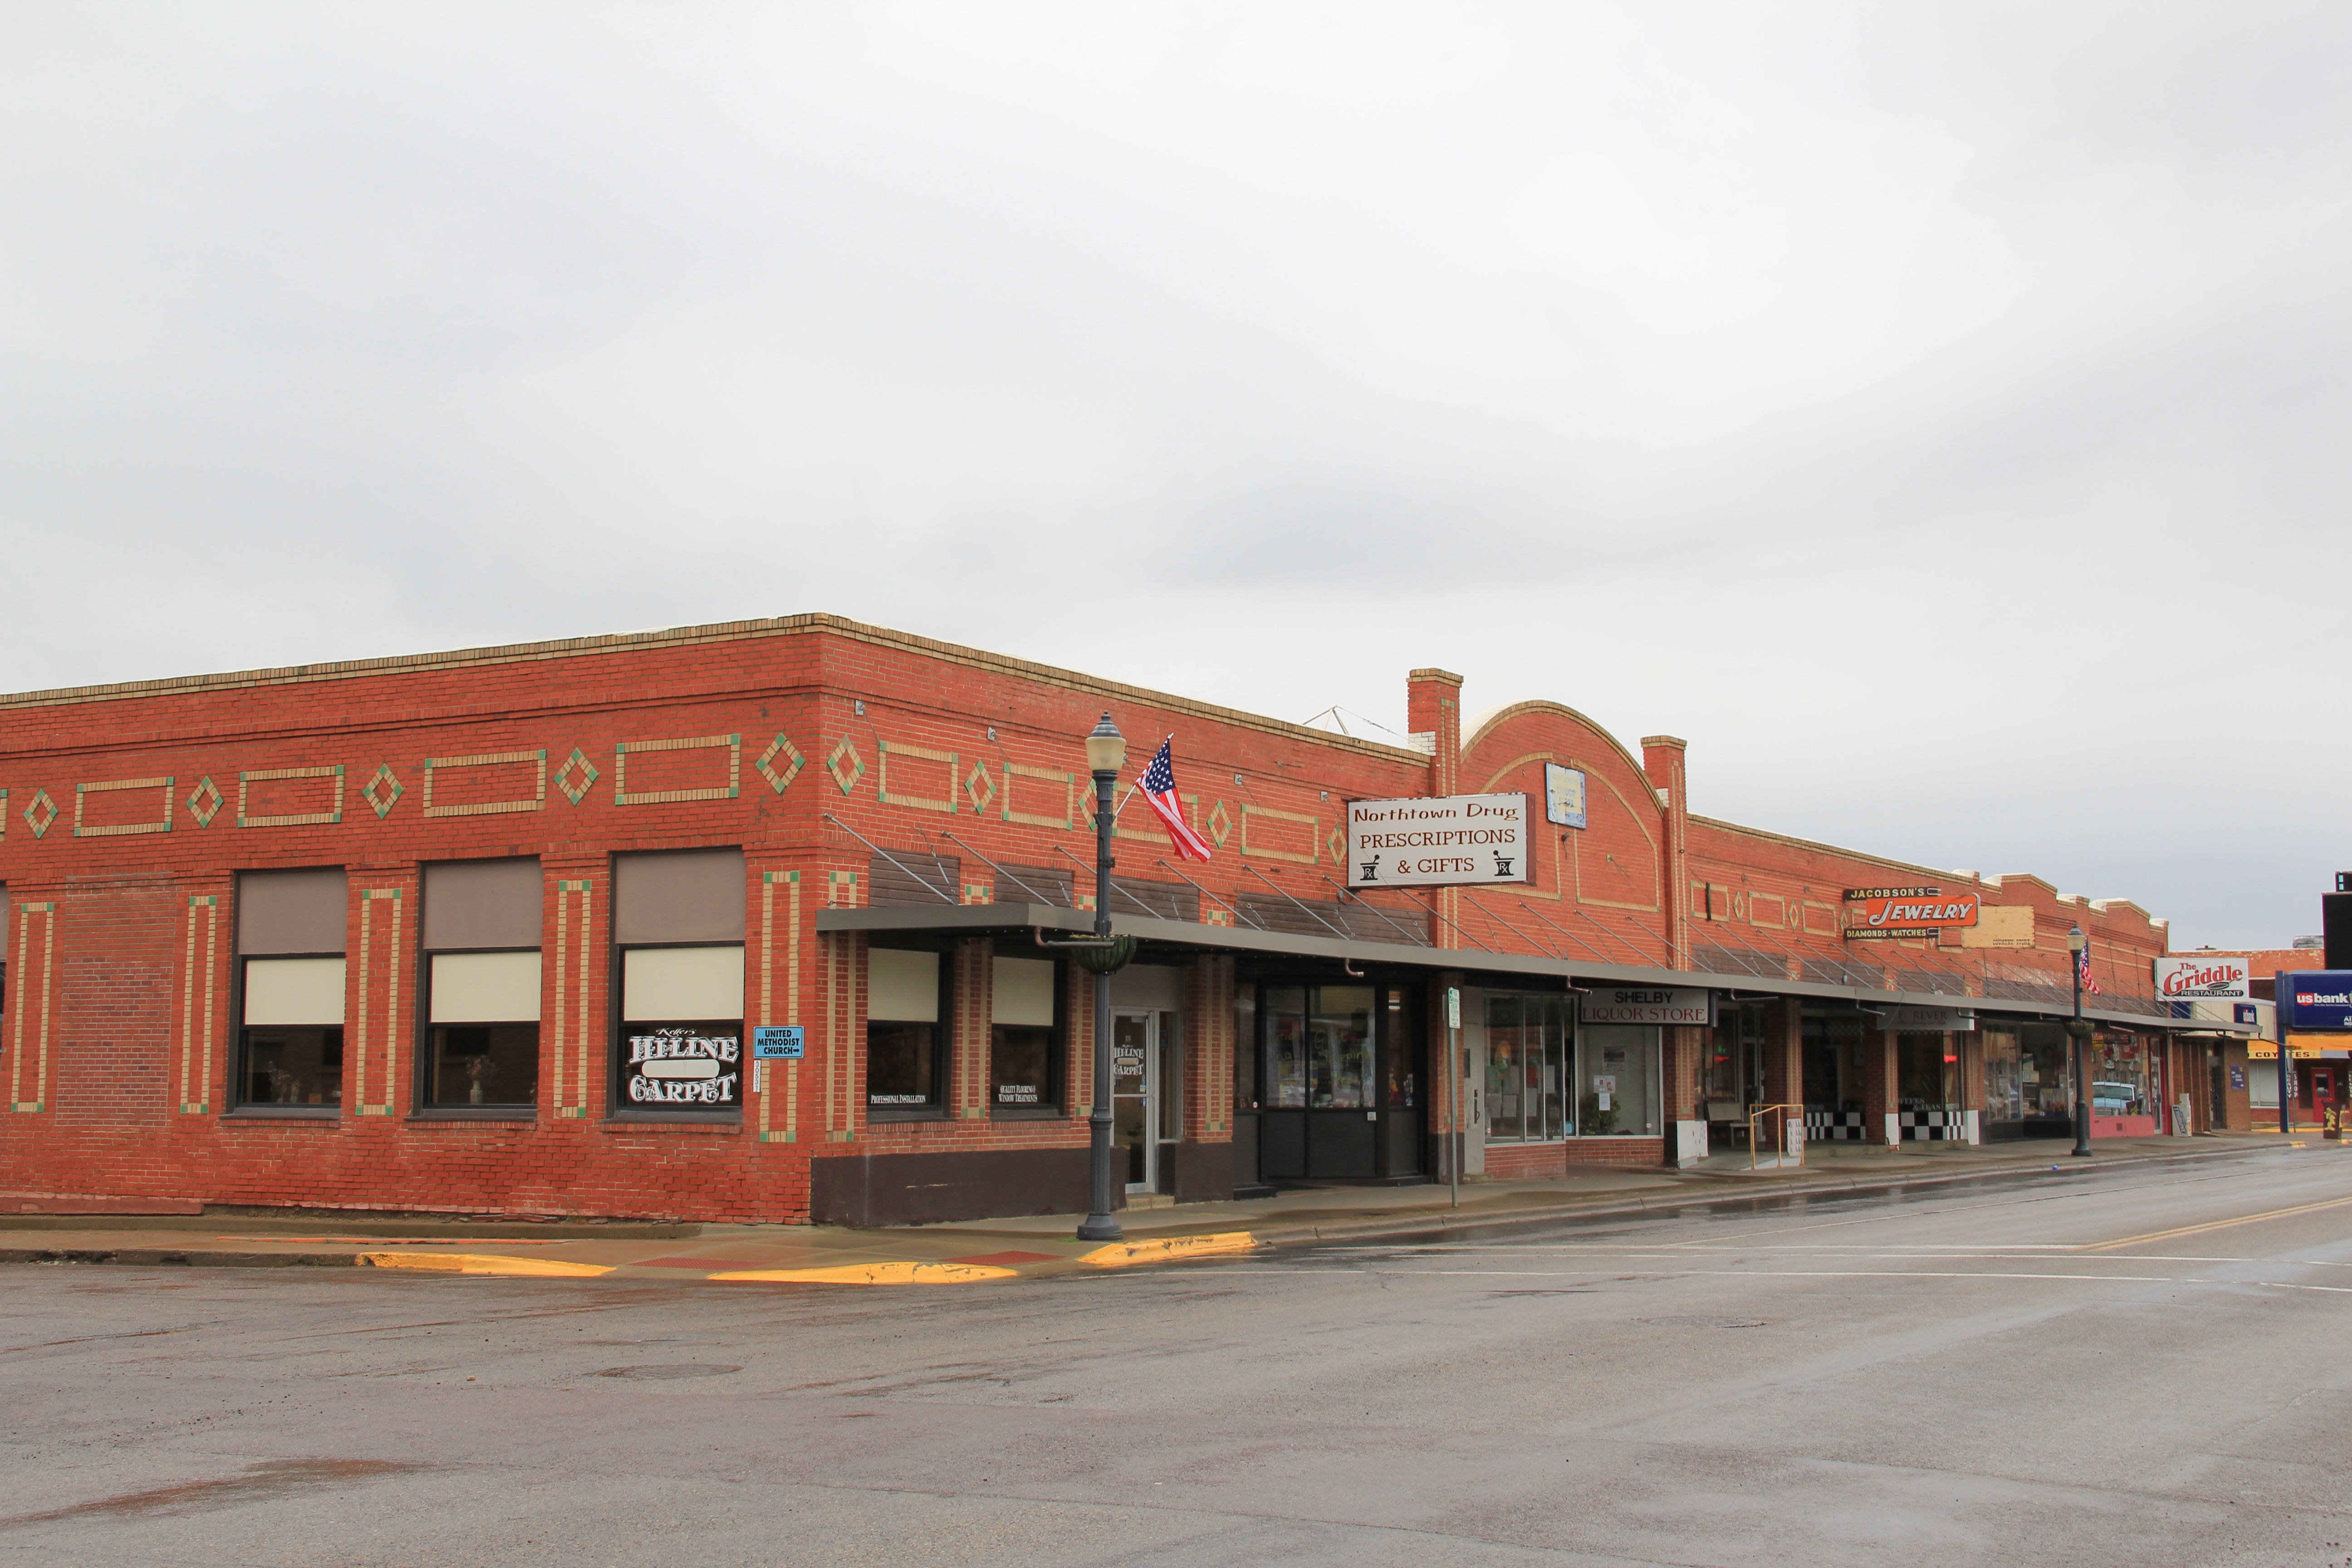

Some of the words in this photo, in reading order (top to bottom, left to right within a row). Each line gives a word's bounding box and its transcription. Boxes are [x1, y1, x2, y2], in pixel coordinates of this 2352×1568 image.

[1355, 809, 1457, 822] Northtown
[1467, 804, 1519, 821] Drug
[1360, 829, 1515, 848] PRESCRIPTIONS
[1397, 860, 1411, 873] &
[1418, 858, 1474, 873] GIFTS
[1851, 888, 1924, 898] JACOBSON'S
[1868, 900, 1973, 926] JEWELRY
[2163, 965, 2243, 995] Griddle
[1614, 991, 1673, 1004] SHELBY
[1583, 1007, 1643, 1021] LIQUOR
[1649, 1008, 1705, 1021] STORE
[656, 1028, 697, 1037] Keller's
[765, 1029, 792, 1038] UNITED
[757, 1038, 799, 1046] METHODIST
[1114, 1063, 1144, 1075] CARPET
[630, 1072, 737, 1103] CARPET
[1000, 1085, 1016, 1093] QUALITY
[1016, 1085, 1033, 1093] FLOORING
[871, 1095, 898, 1103] PROFESSIONAL
[899, 1095, 926, 1103] INSTALLATION
[999, 1094, 1014, 1102] WINDOW
[1015, 1094, 1038, 1102] TREATMENTS
